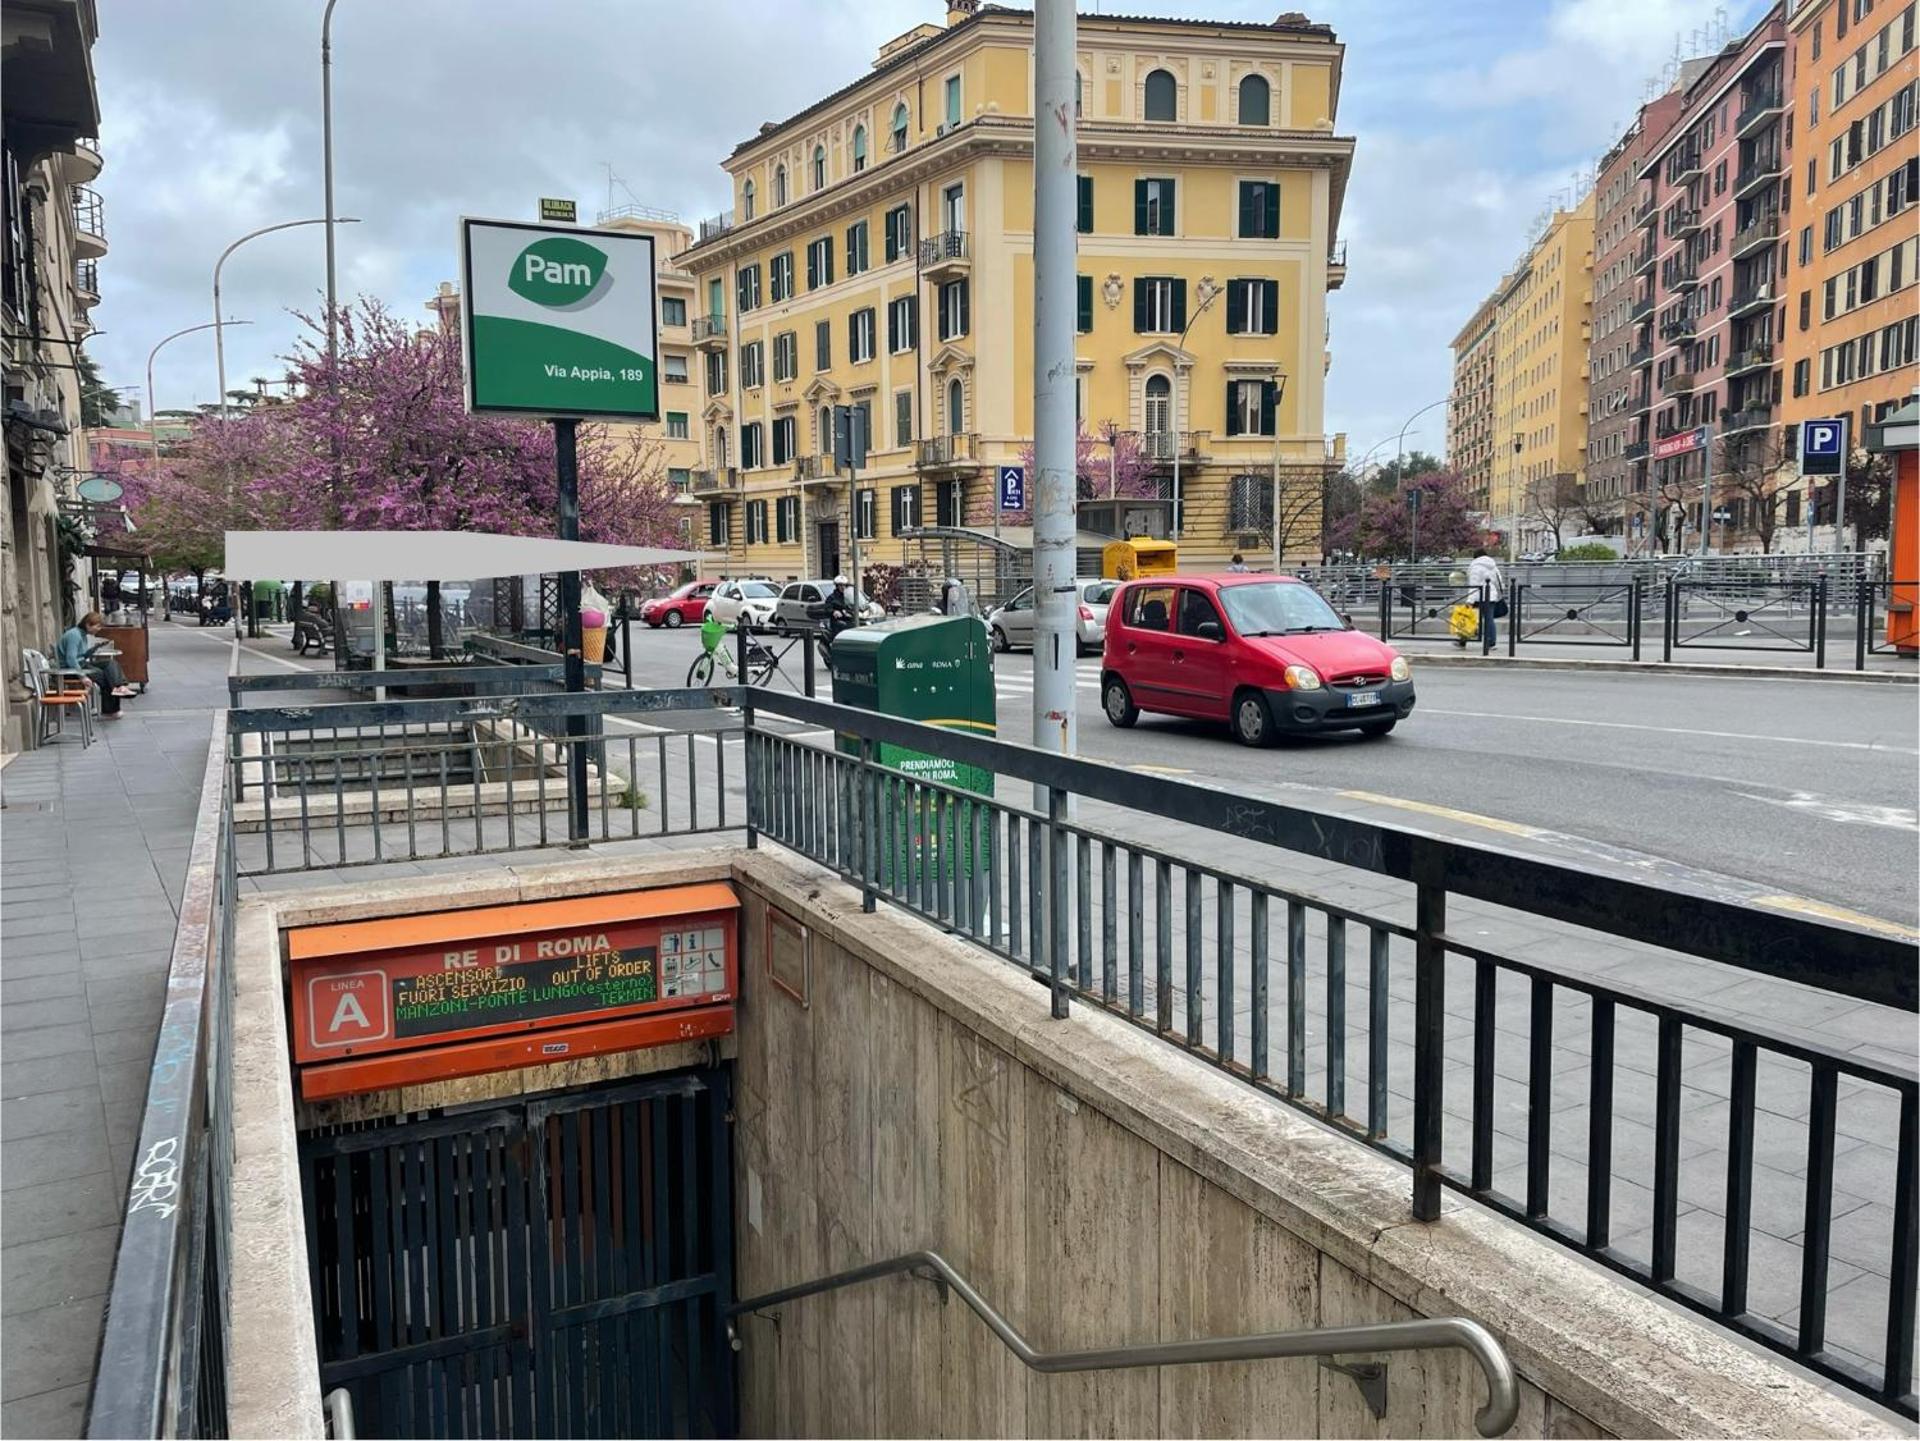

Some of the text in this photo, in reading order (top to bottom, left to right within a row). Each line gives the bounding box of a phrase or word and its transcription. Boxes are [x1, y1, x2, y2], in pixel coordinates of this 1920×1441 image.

[525, 253, 591, 286] Pam
[544, 364, 644, 382] Via Appia, 189
[1814, 427, 1833, 451] P
[900, 759, 955, 771] PRENDIAMOCI
[932, 769, 958, 781] ROMA,
[444, 934, 611, 970] RE DI ROMA
[576, 950, 621, 969] LIFTS
[416, 965, 504, 989] ASCENSORI
[552, 960, 652, 986] OUT OF ORDER
[330, 979, 366, 992] LINEA
[399, 977, 526, 1006] FUORI SERVIZIO
[329, 992, 371, 1033] A
[396, 990, 528, 1021] MANZONI-PONTE
